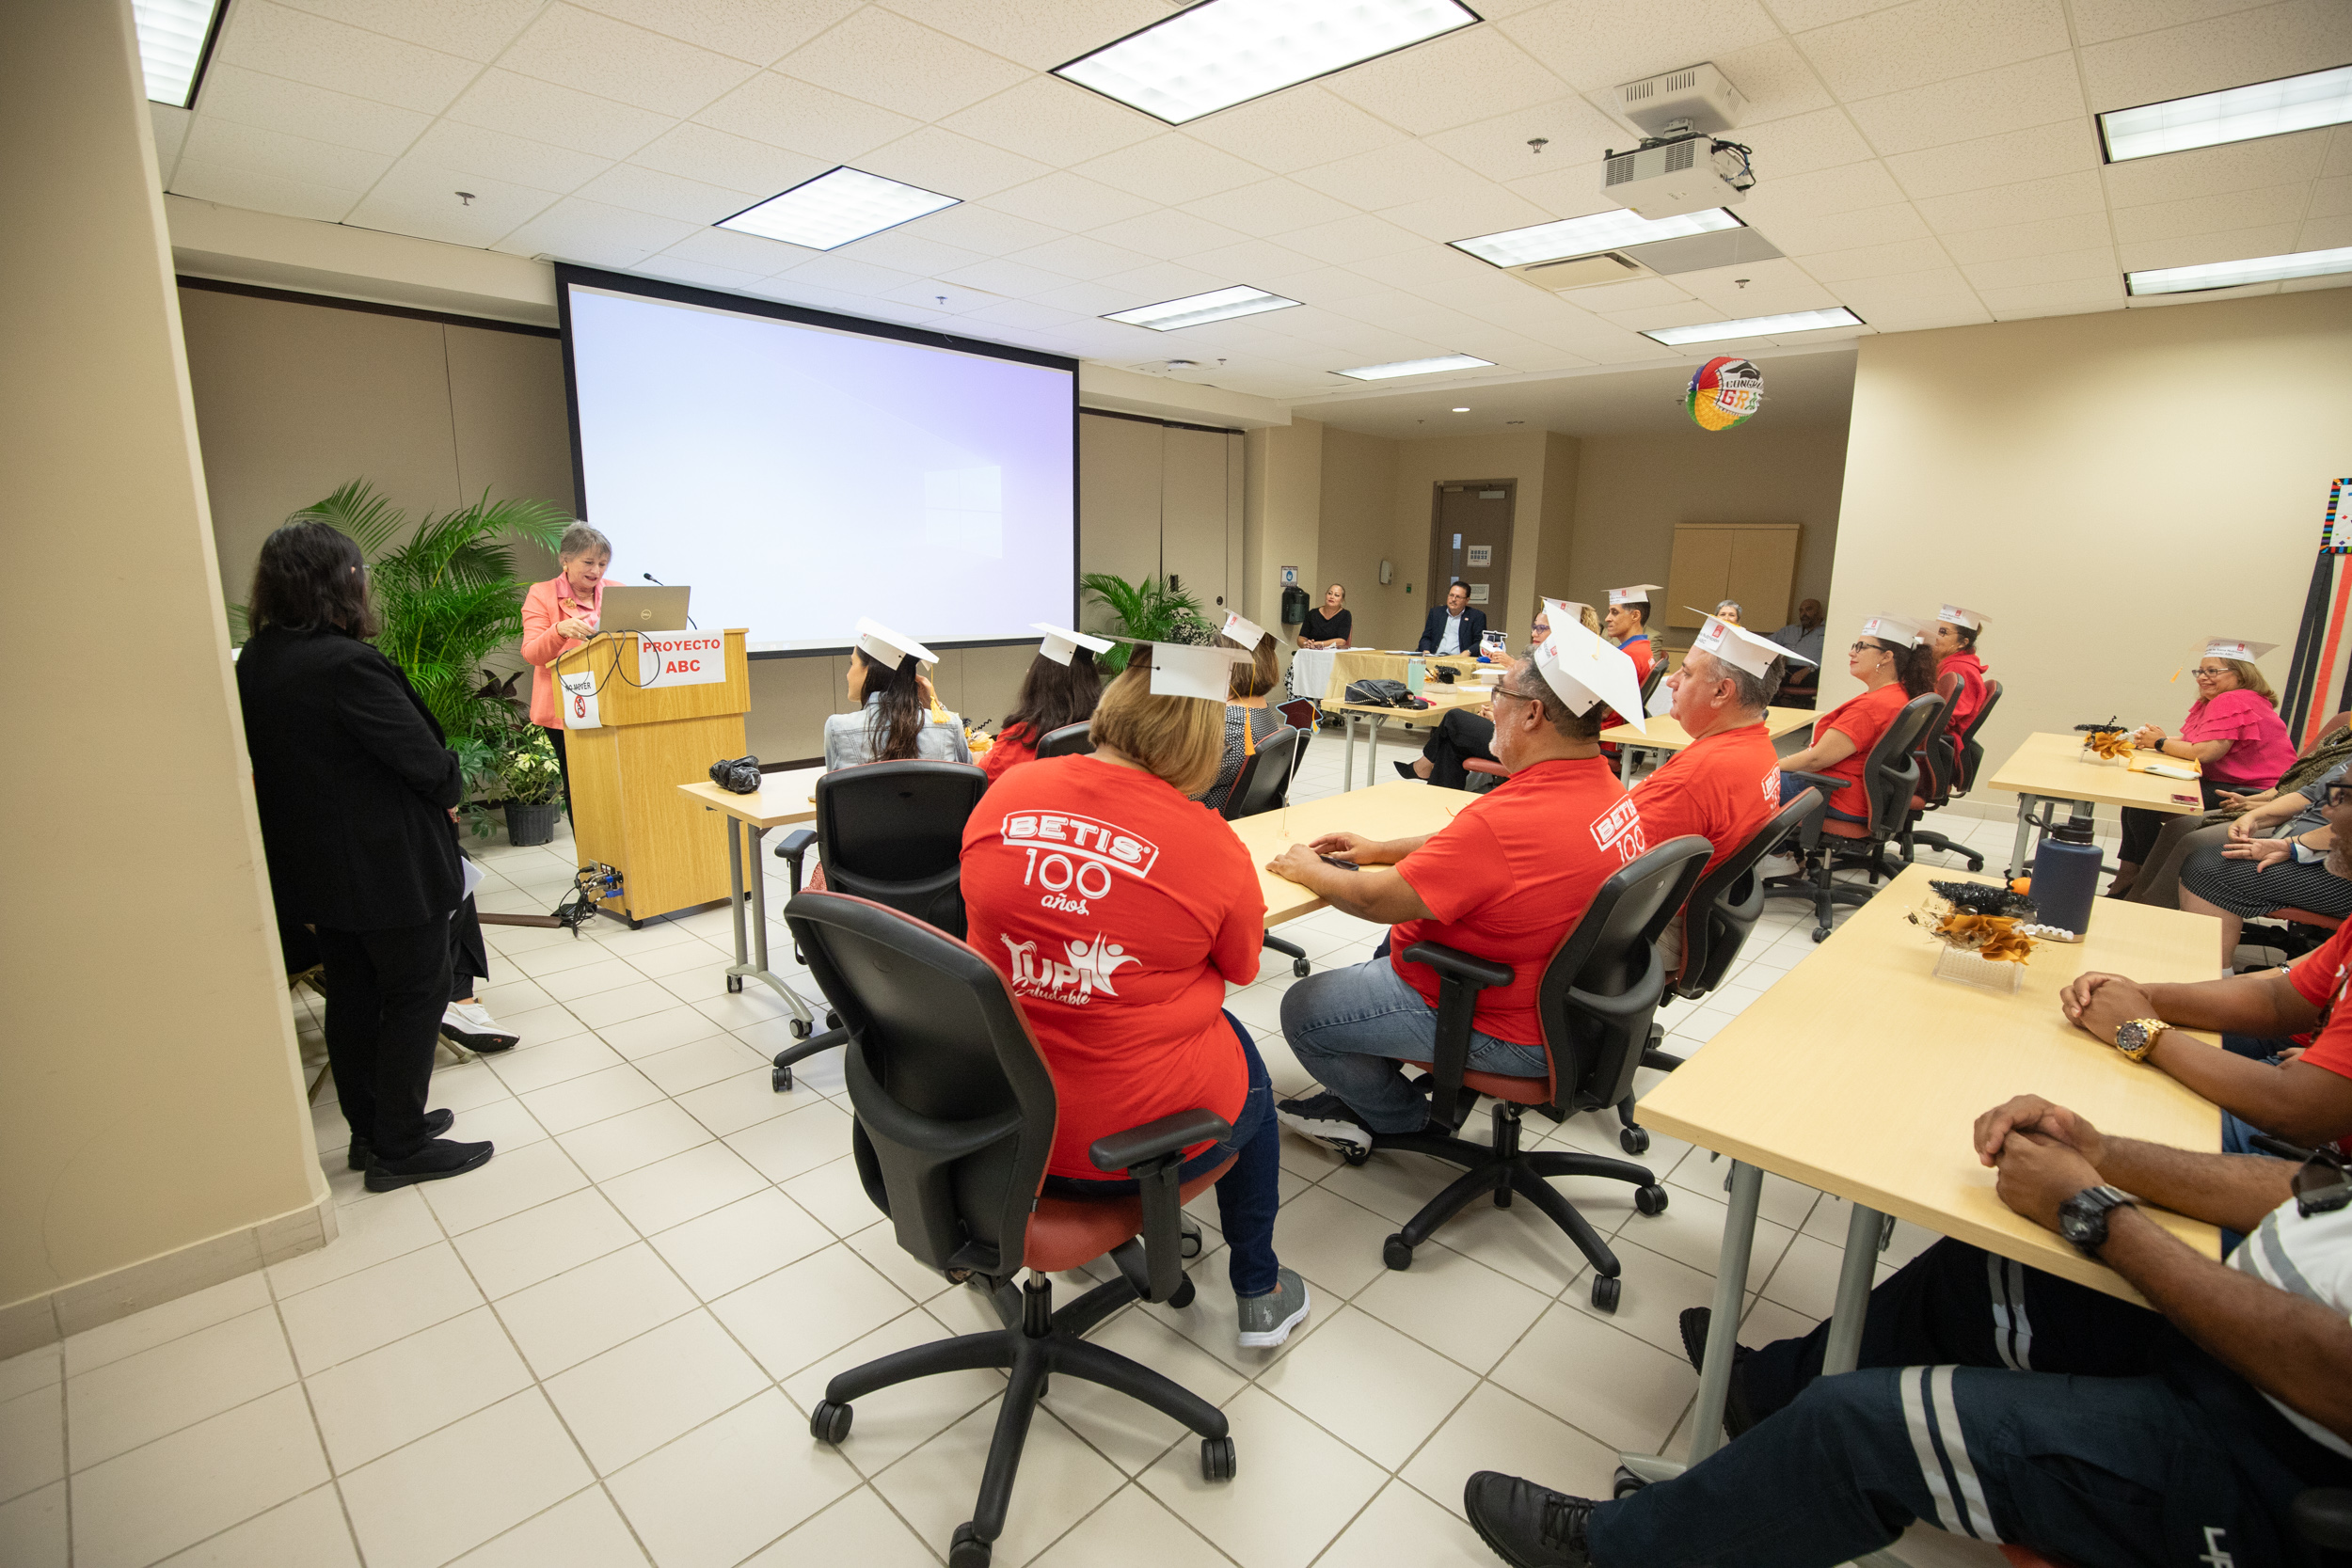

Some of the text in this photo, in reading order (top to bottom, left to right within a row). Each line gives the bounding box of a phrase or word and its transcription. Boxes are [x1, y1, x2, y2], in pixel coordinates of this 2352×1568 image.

[643, 639, 721, 653] PROYECTO
[665, 659, 701, 673] ABC
[574, 682, 592, 690] MOVER
[1616, 825, 1645, 863] 100
[1024, 848, 1112, 899] 100
[1041, 893, 1089, 916] años
[1011, 975, 1091, 1006] Saludable
